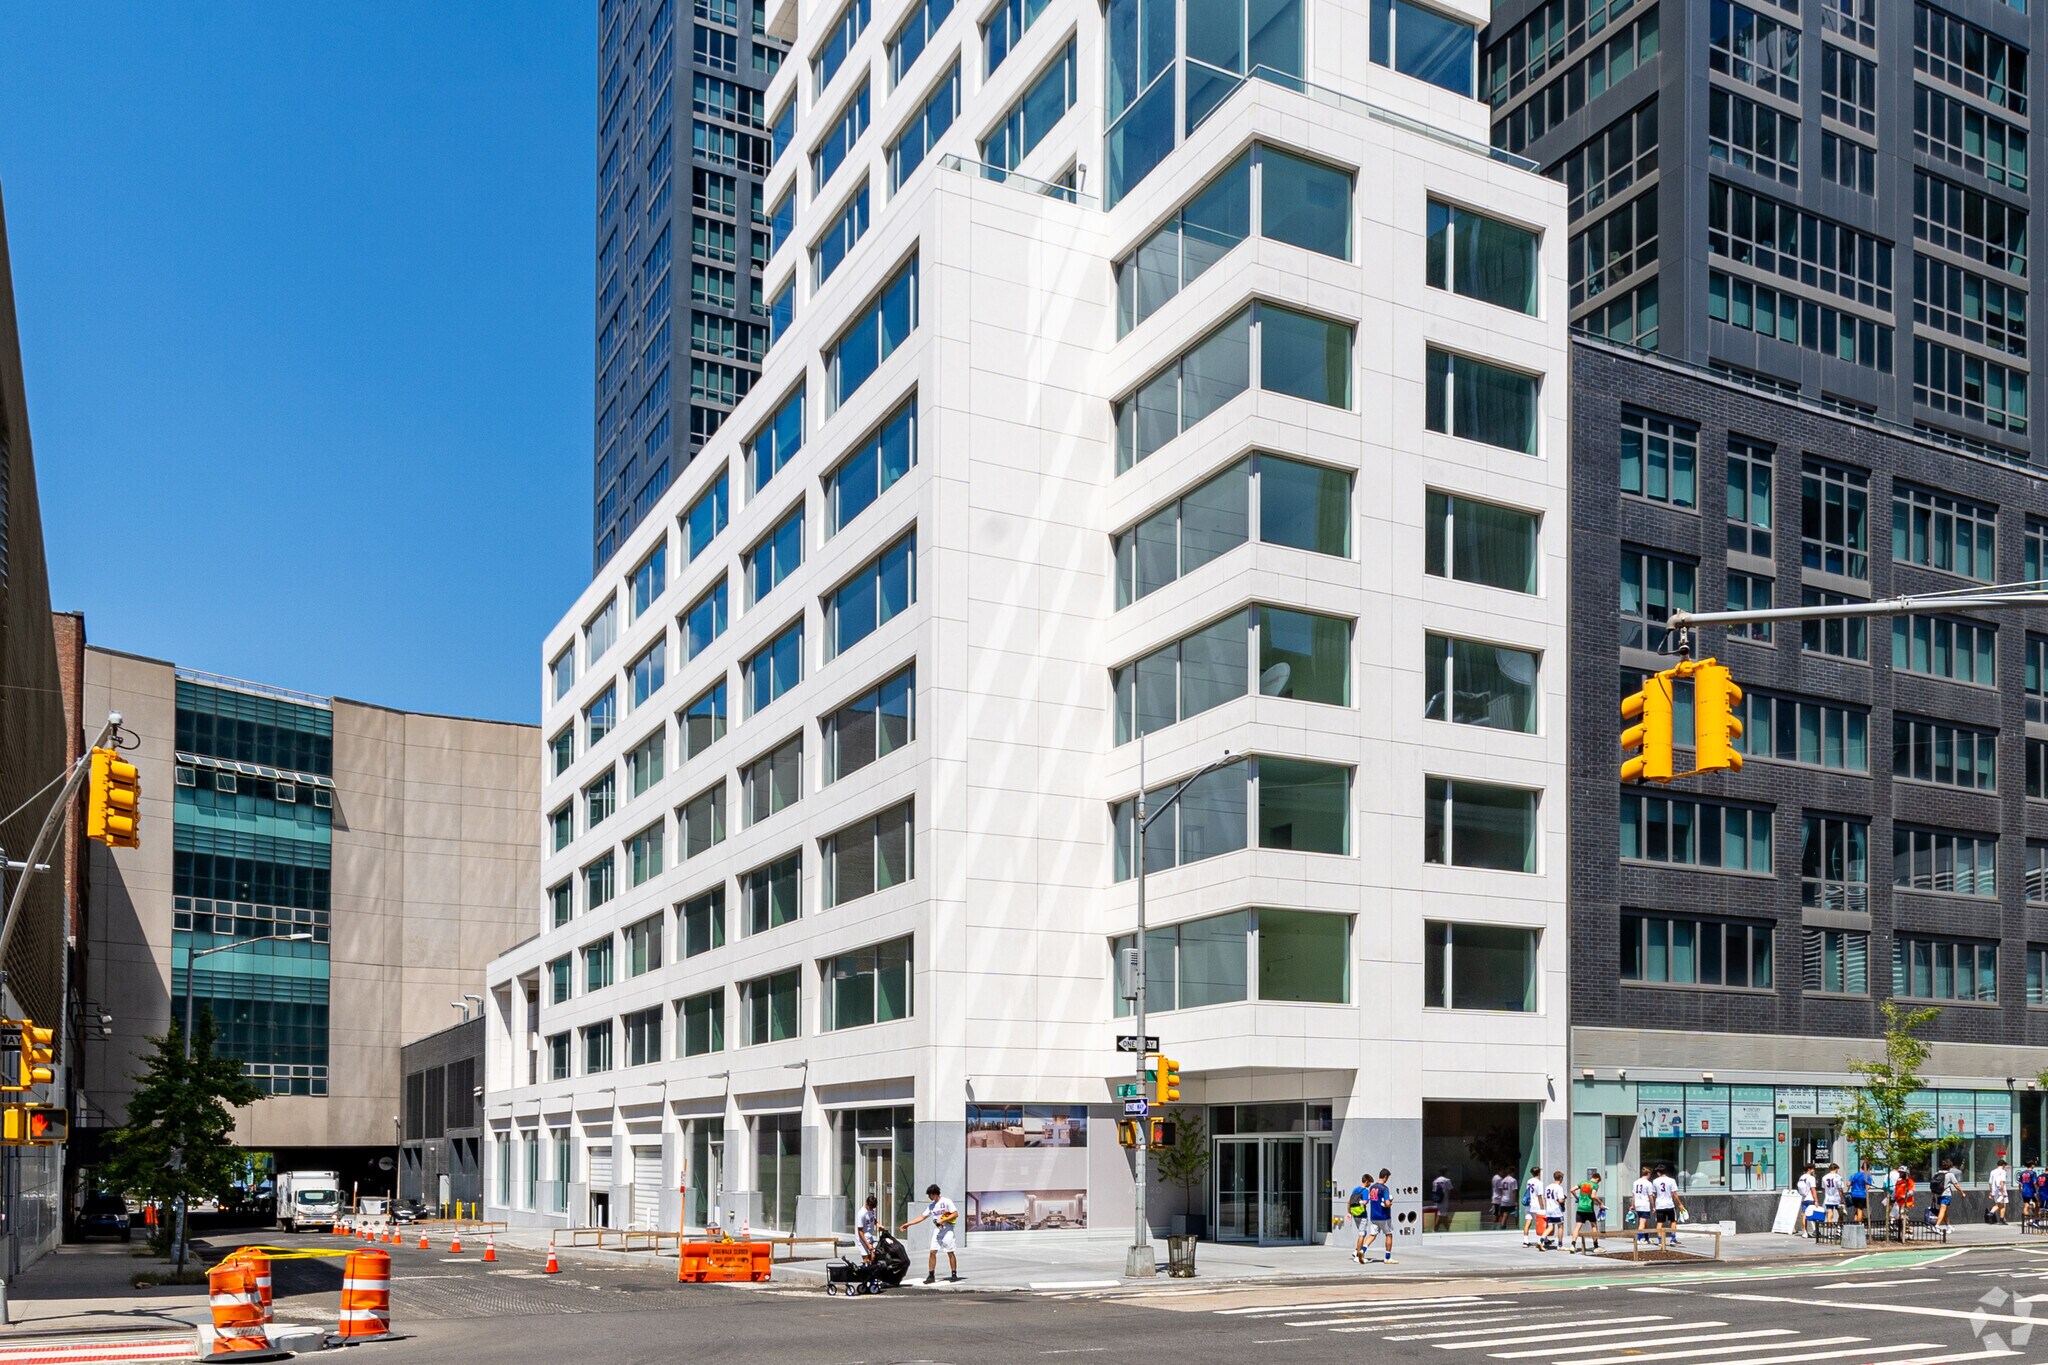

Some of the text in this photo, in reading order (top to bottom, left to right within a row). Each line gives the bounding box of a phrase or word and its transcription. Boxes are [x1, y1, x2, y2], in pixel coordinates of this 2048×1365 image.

[1122, 1040, 1135, 1048] ONE
[1127, 1103, 1136, 1111] ONE
[1661, 1114, 1667, 1123] 7
[1660, 1182, 1666, 1192] 3
[1826, 1178, 1835, 1188] 31
[1635, 1184, 1643, 1194] 13
